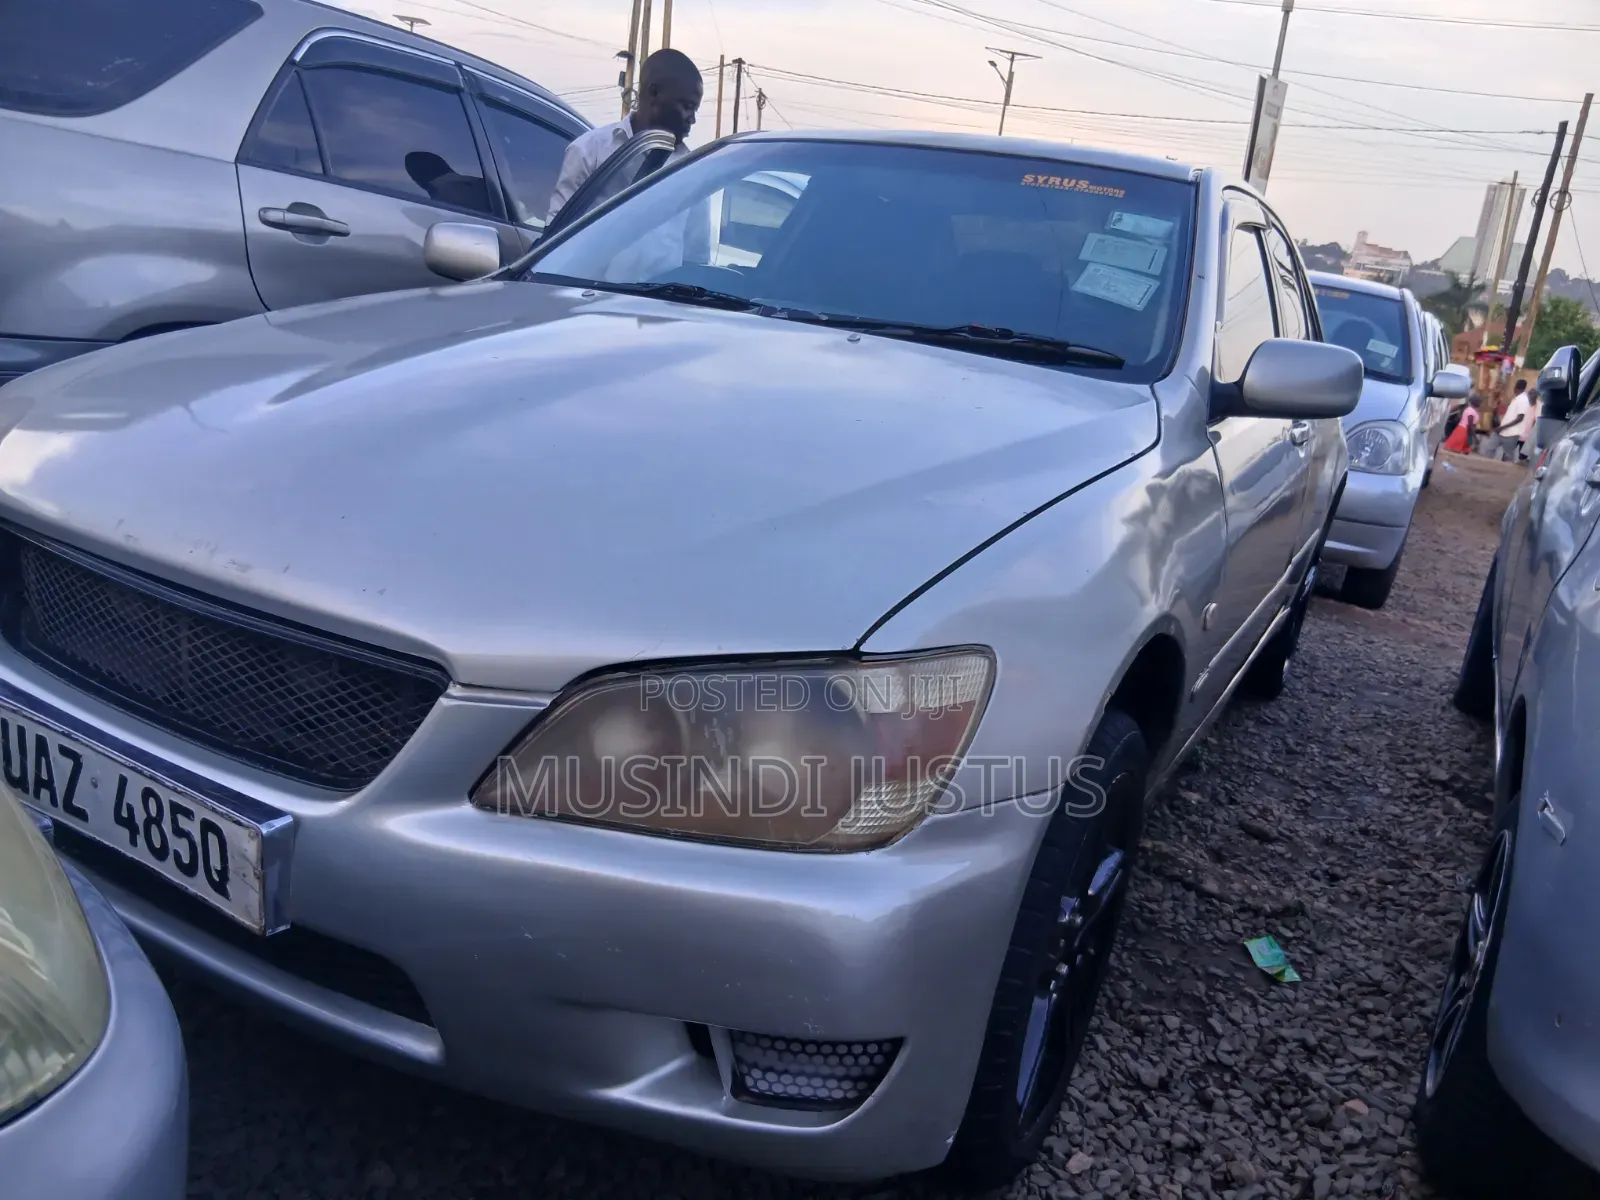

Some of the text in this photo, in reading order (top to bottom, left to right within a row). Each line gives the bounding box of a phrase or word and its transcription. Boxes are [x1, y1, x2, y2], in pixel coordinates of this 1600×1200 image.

[1022, 174, 1090, 189] SYRUS
[0, 717, 231, 901] UAZ 485Q
